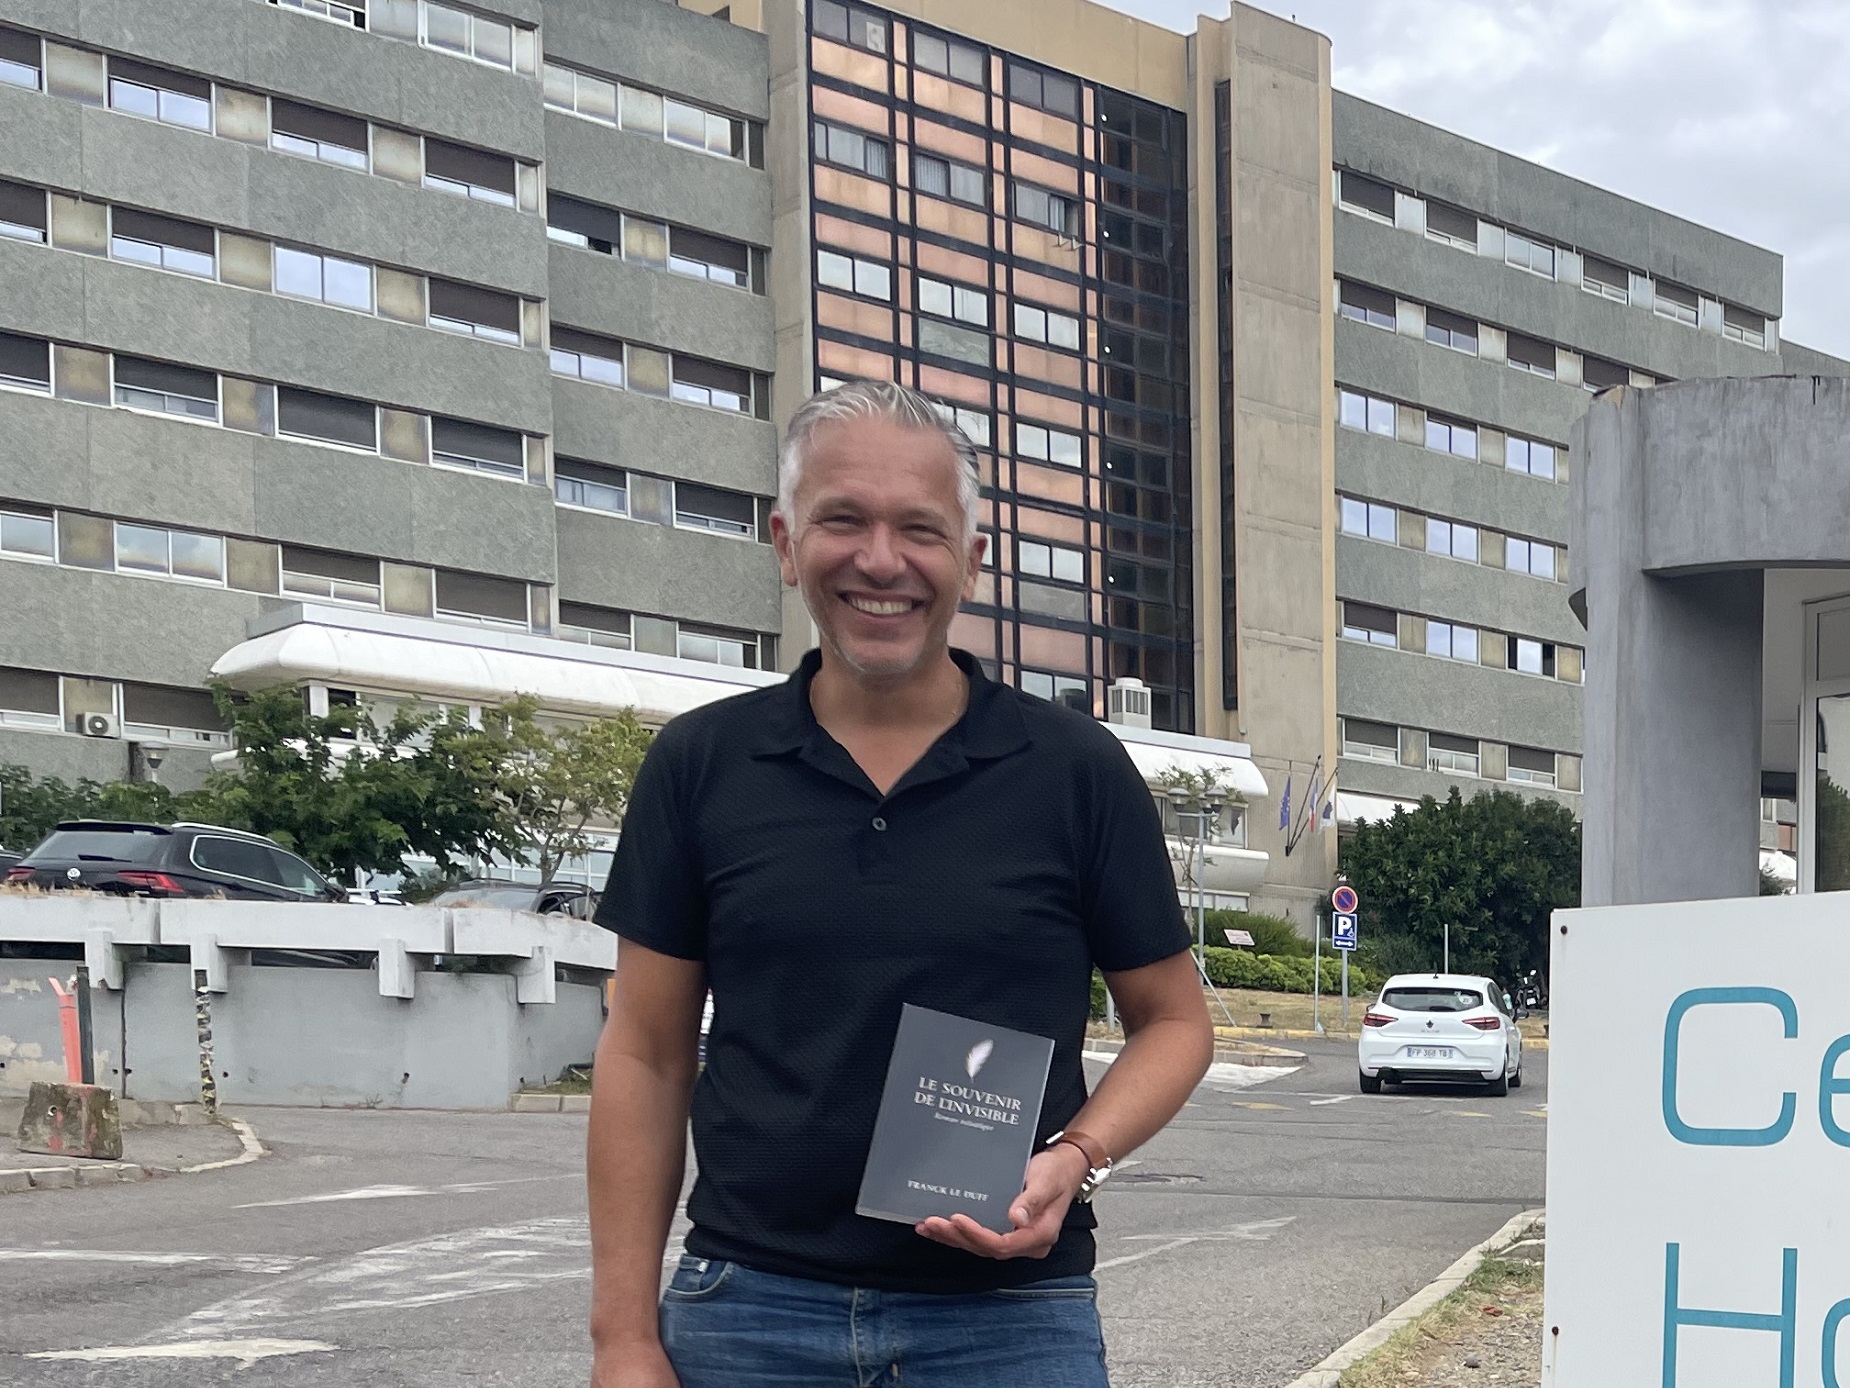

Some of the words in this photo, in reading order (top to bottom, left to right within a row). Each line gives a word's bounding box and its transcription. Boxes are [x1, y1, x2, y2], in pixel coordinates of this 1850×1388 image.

[1338, 916, 1352, 935] P
[914, 1091, 936, 1107] DE
[919, 1076, 938, 1092] LE
[941, 1082, 1022, 1111] SOUVENIR
[907, 1180, 947, 1195] FRANCK
